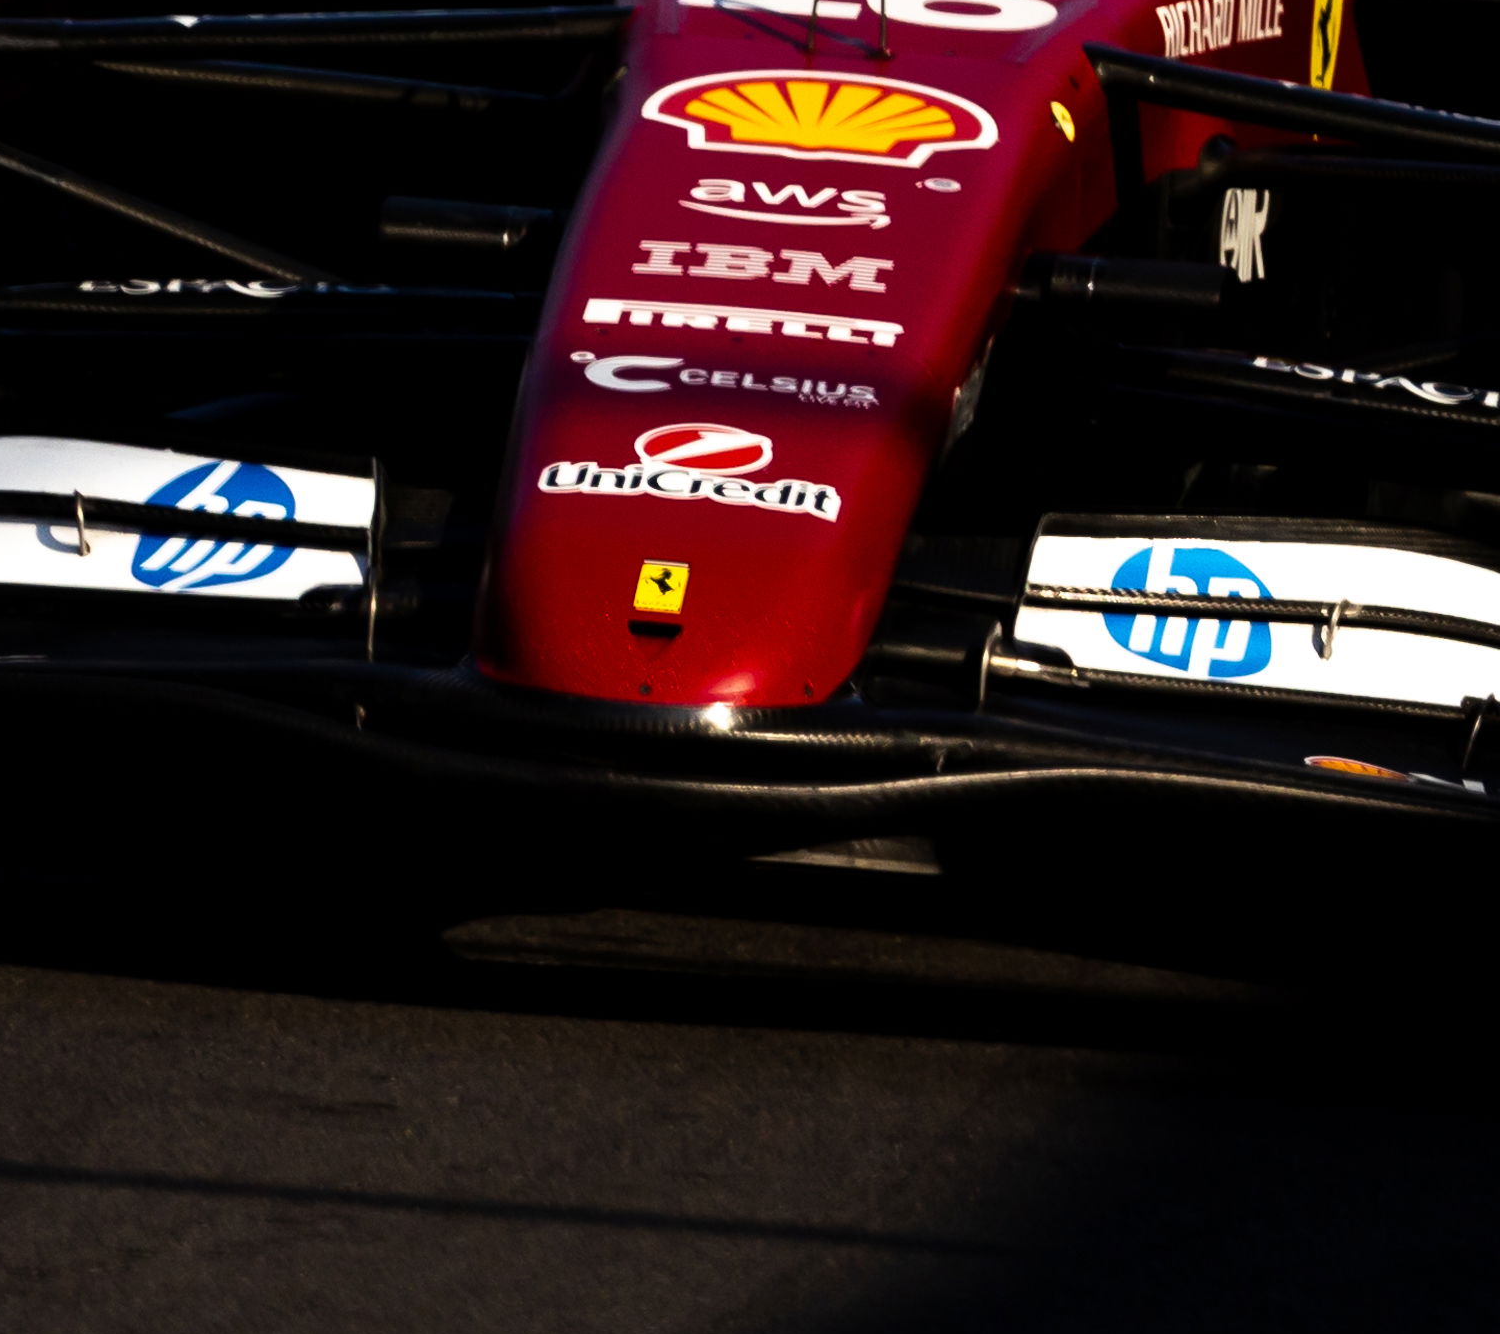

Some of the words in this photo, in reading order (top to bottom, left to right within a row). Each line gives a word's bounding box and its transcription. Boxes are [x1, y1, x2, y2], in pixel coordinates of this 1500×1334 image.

[690, 178, 888, 215] aws
[631, 239, 895, 294] IBM
[582, 297, 905, 348] PIRELLI
[678, 368, 878, 403] CELSIUS
[538, 462, 842, 523] UniCredit
[138, 459, 289, 592] hp
[1127, 545, 1263, 680] hp
